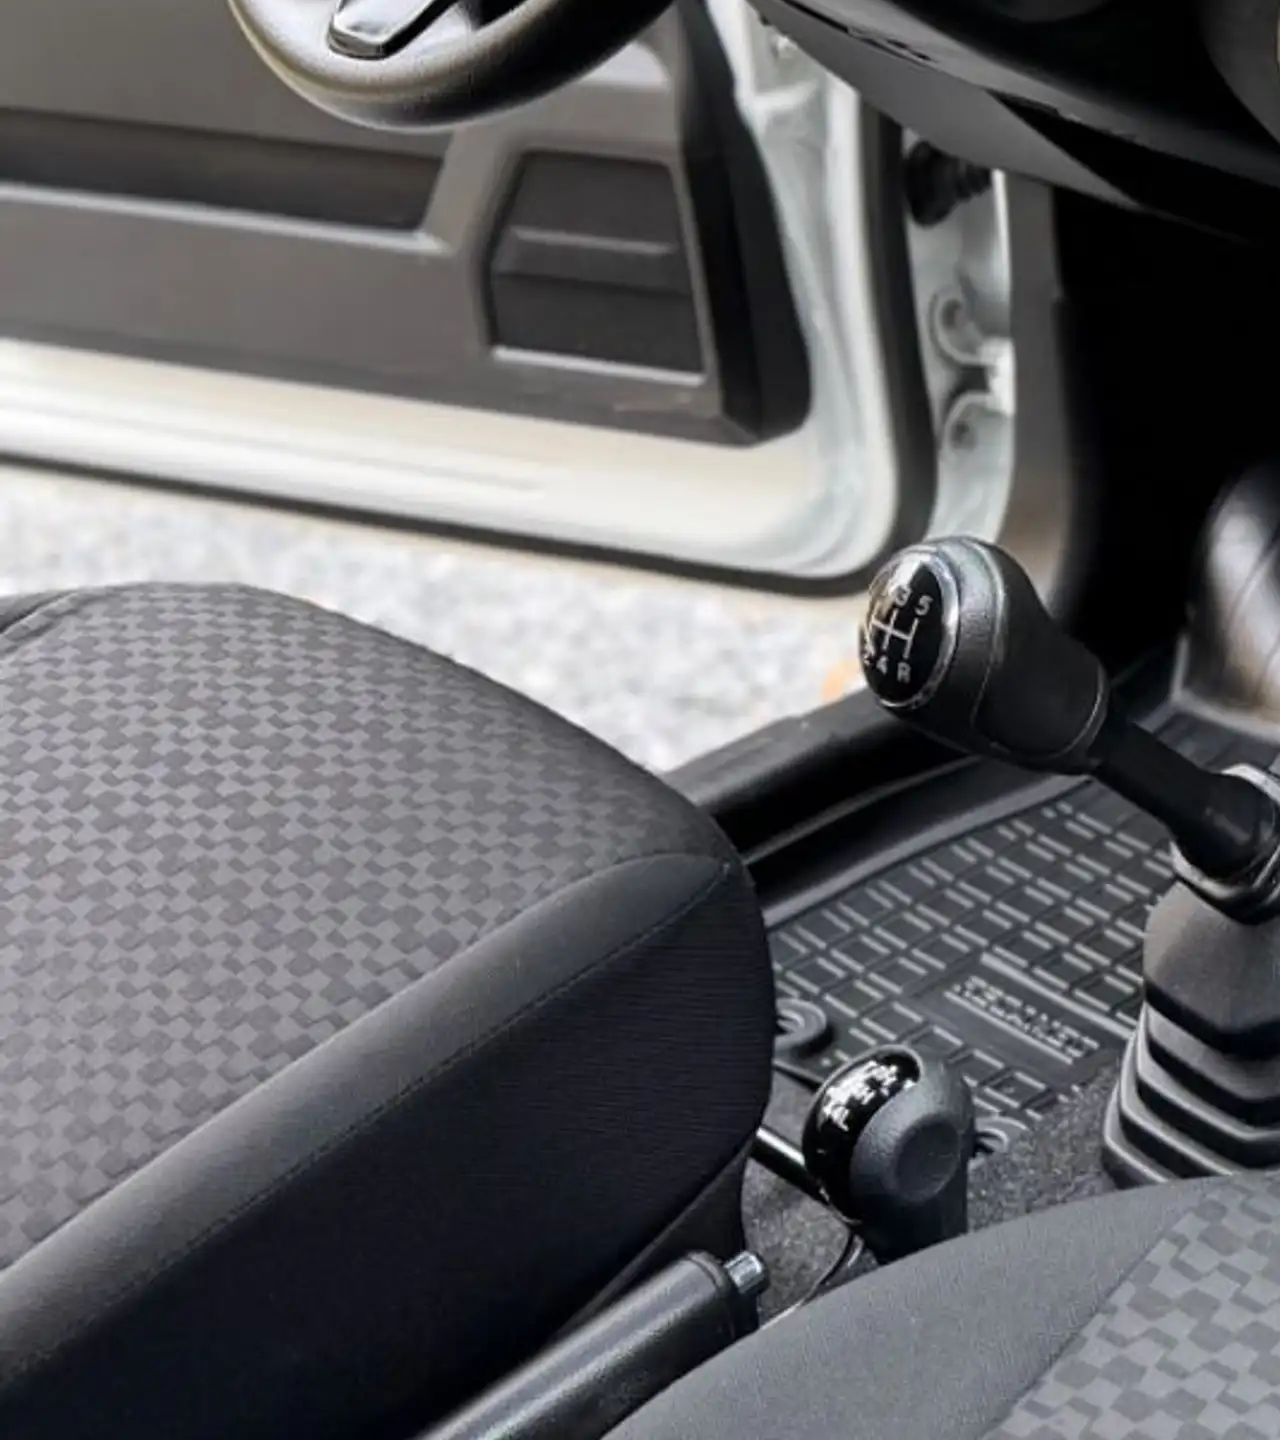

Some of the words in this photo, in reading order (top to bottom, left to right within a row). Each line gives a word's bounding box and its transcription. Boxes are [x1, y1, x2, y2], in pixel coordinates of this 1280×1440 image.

[895, 585, 911, 606] 3
[915, 594, 934, 617] 5
[875, 657, 889, 675] 4
[897, 662, 913, 684] R
